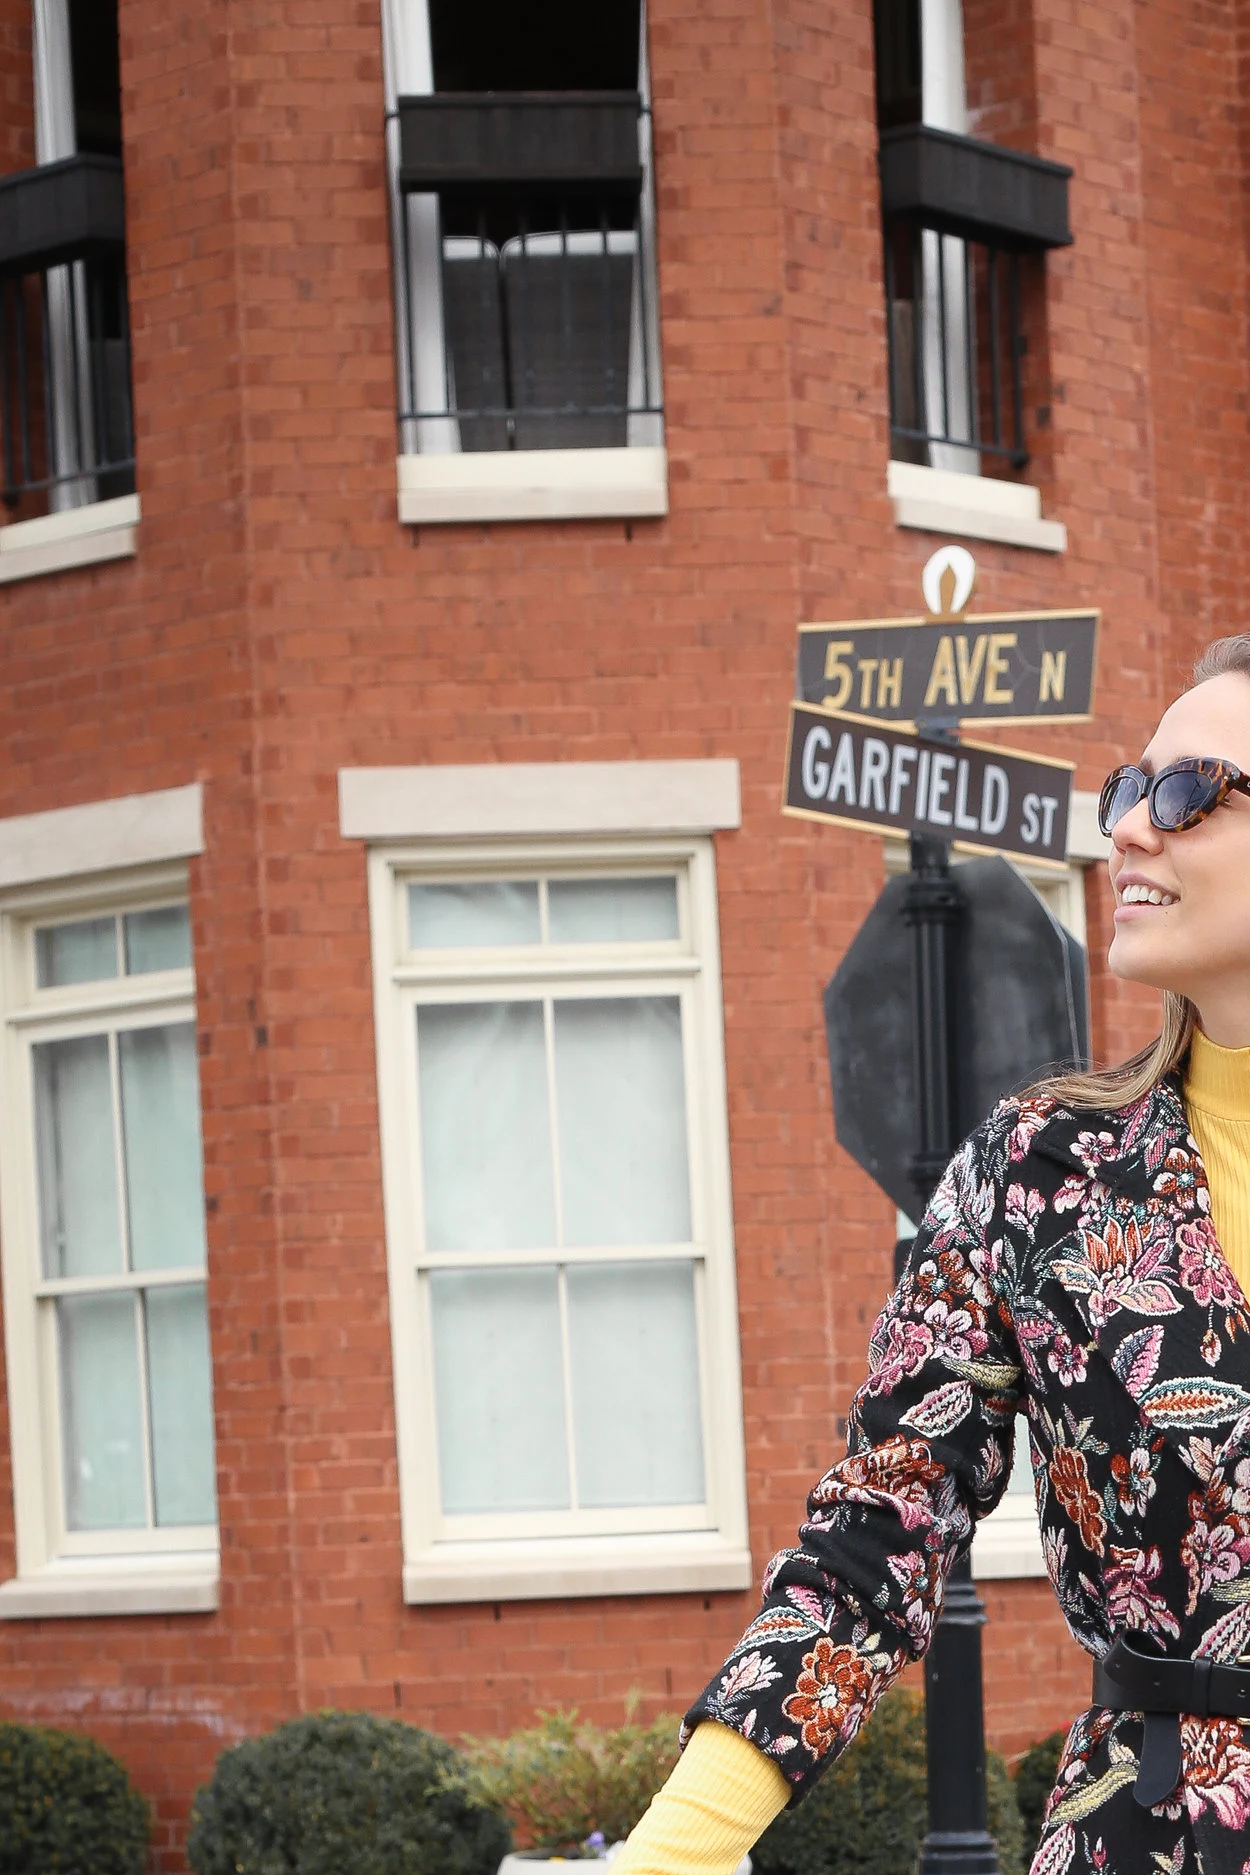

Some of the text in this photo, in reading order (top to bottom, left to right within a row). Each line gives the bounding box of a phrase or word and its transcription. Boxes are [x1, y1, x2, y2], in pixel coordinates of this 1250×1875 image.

[822, 633, 1066, 709] 5TH AVE N
[802, 726, 1058, 846] GARFIELD ST
